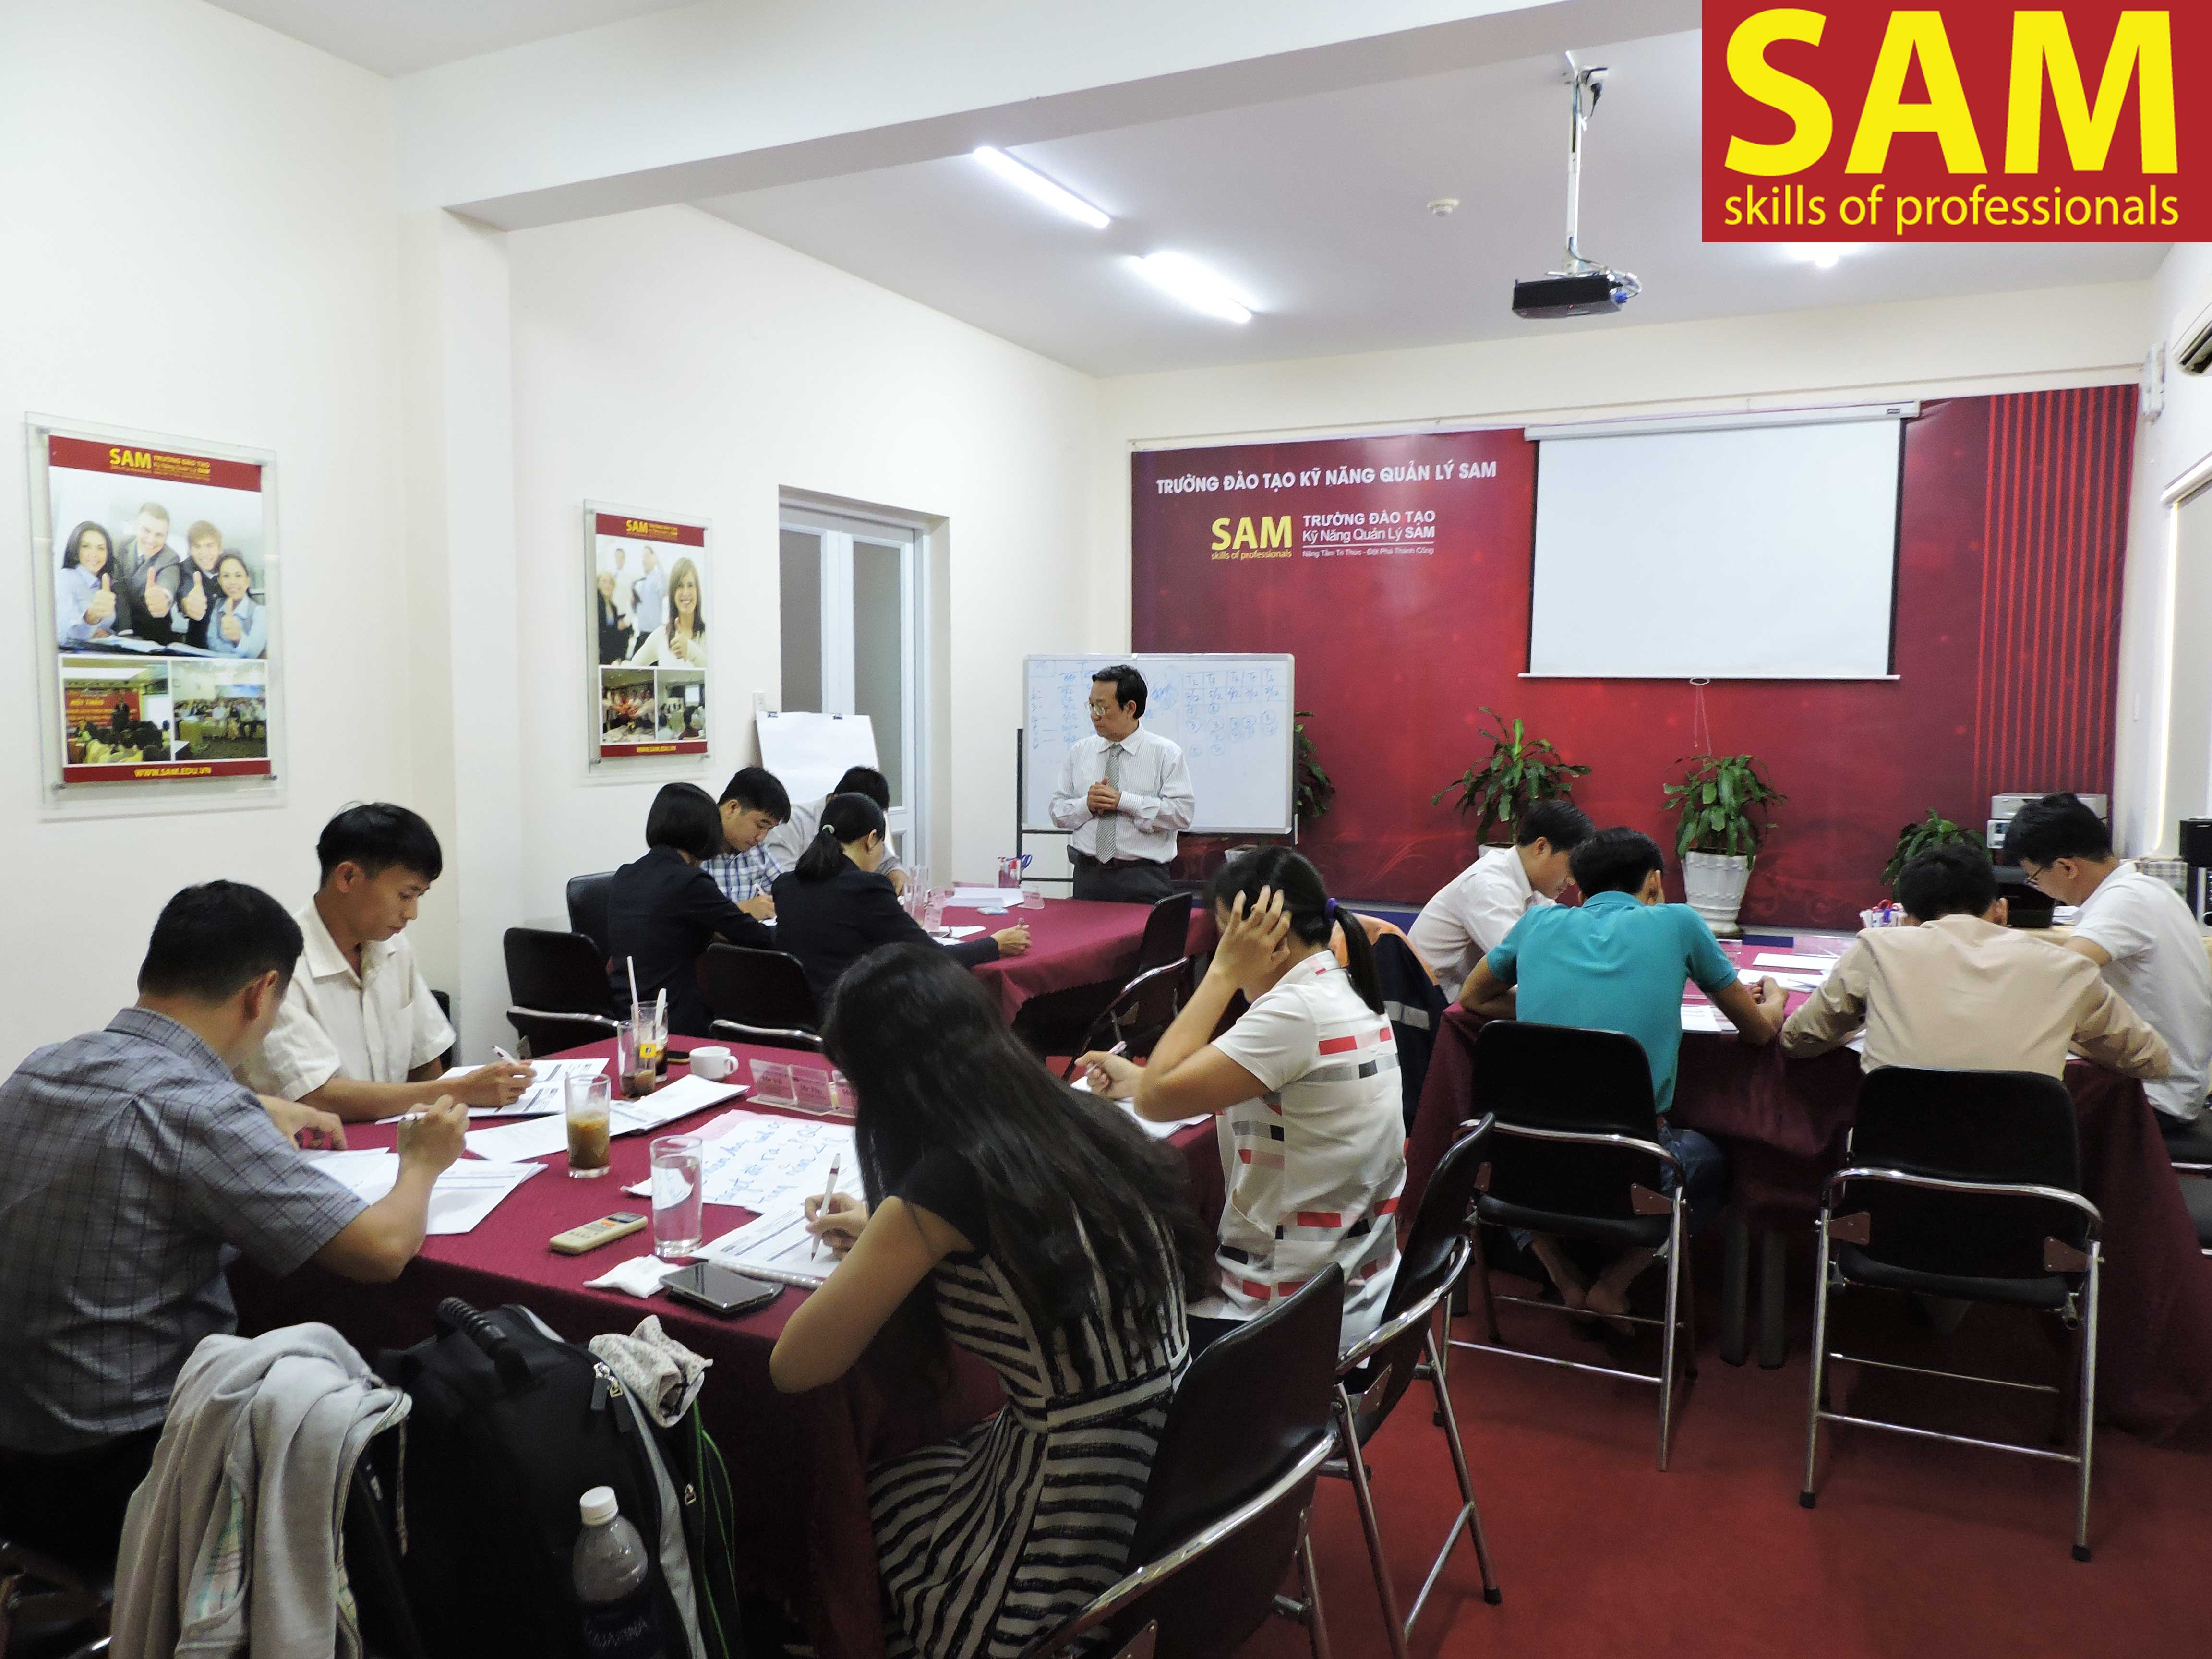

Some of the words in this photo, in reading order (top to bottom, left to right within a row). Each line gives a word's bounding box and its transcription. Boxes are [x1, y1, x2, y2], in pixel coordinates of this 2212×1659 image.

[109, 448, 152, 469] SAM
[1156, 473, 1220, 494] TRƯỜNG
[1223, 470, 1259, 491] ĐÀO
[1262, 472, 1296, 493] TẠO
[1300, 467, 1321, 487] KỸ
[1325, 465, 1375, 485] NĂNG
[1380, 460, 1430, 482] QUẢN
[1435, 459, 1455, 480] LÝ
[1459, 461, 1497, 479] SAM
[626, 519, 648, 534] SAM
[1302, 511, 1365, 527] TRƯỜNG
[1369, 509, 1401, 524] ĐÀO
[1405, 510, 1436, 525] TẠO
[1211, 515, 1293, 551] SAM
[1302, 529, 1318, 545] Kỹ
[1320, 529, 1351, 543] Năng
[1353, 528, 1385, 540] Quản
[1388, 528, 1402, 541] Lý
[1405, 526, 1436, 538] SAM
